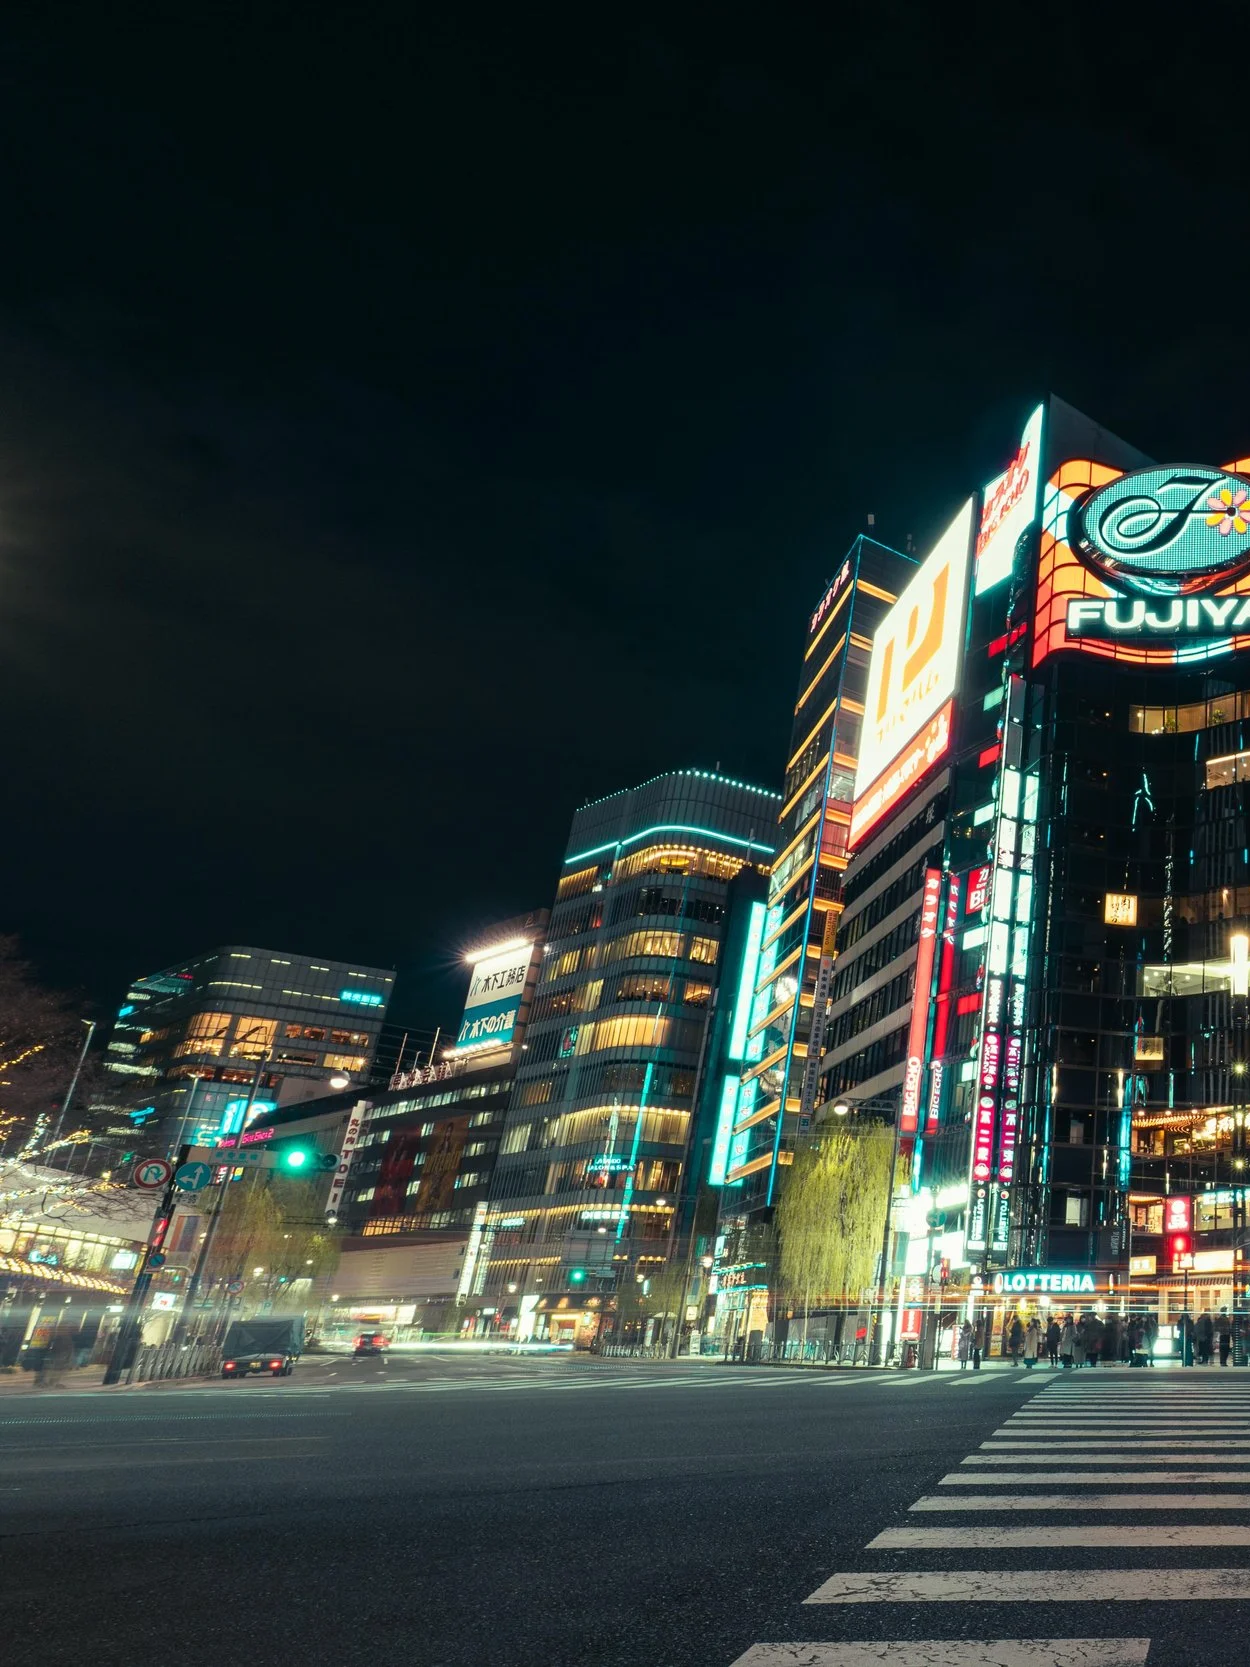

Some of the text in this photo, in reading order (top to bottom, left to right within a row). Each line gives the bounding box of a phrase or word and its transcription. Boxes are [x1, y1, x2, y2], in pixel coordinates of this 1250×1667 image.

[481, 965, 526, 993] 木下工務店
[469, 1009, 517, 1039] 木下の介護
[1003, 1113, 1017, 1162] 不二家
[581, 1211, 630, 1220] DIESEL
[1003, 1274, 1095, 1292] LOTTERIA
